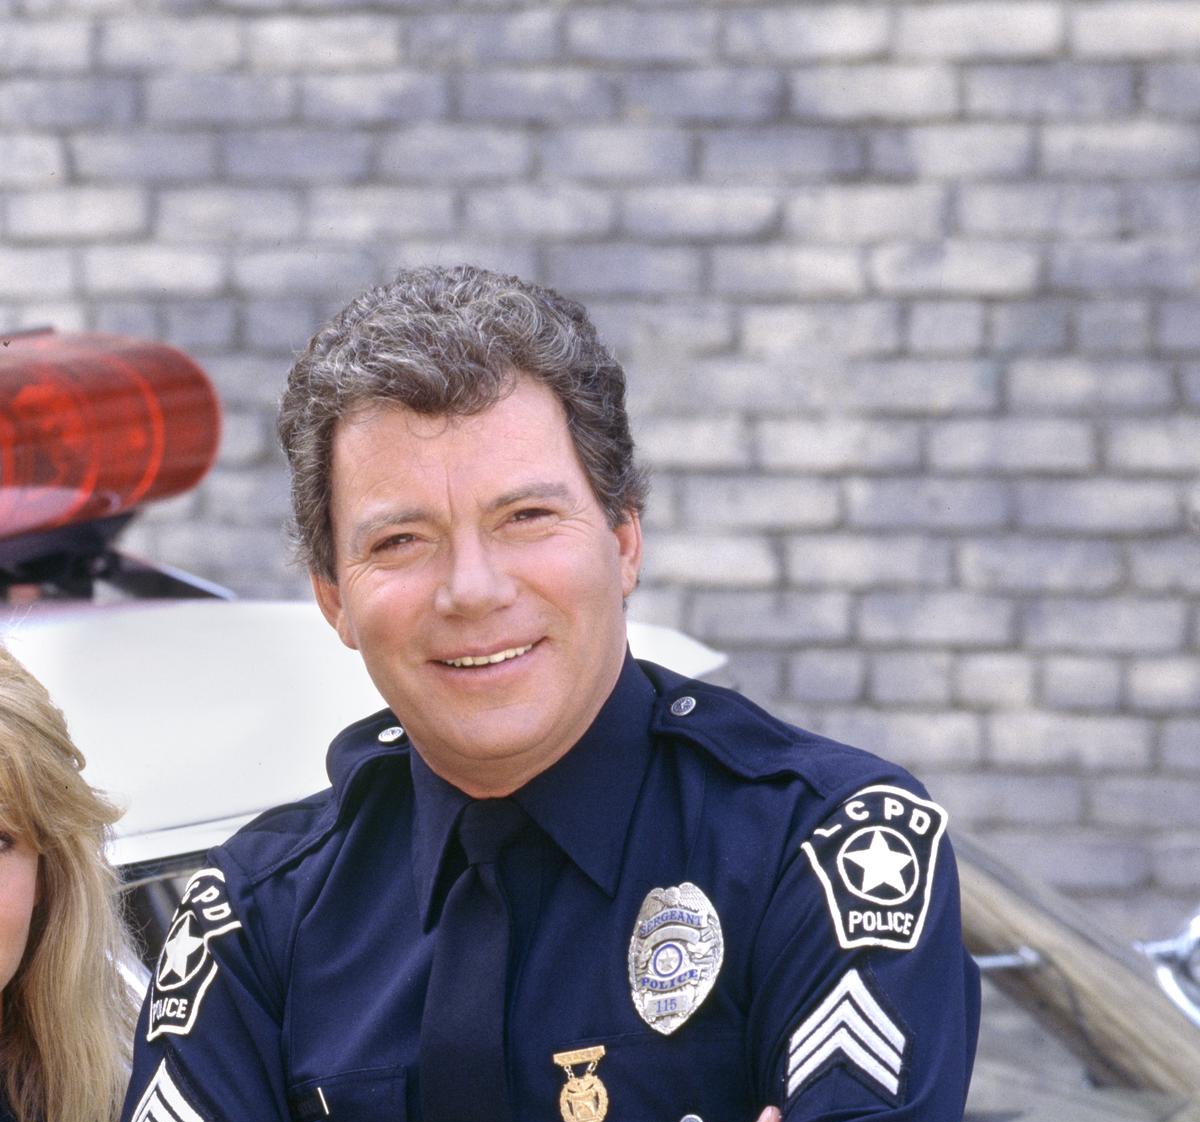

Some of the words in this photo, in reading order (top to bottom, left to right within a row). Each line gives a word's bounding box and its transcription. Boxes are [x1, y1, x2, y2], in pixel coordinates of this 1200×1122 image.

[639, 911, 704, 937] SERGEANT
[848, 911, 914, 936] POLICE
[641, 968, 699, 990] POLICE
[655, 998, 678, 1014] 115
